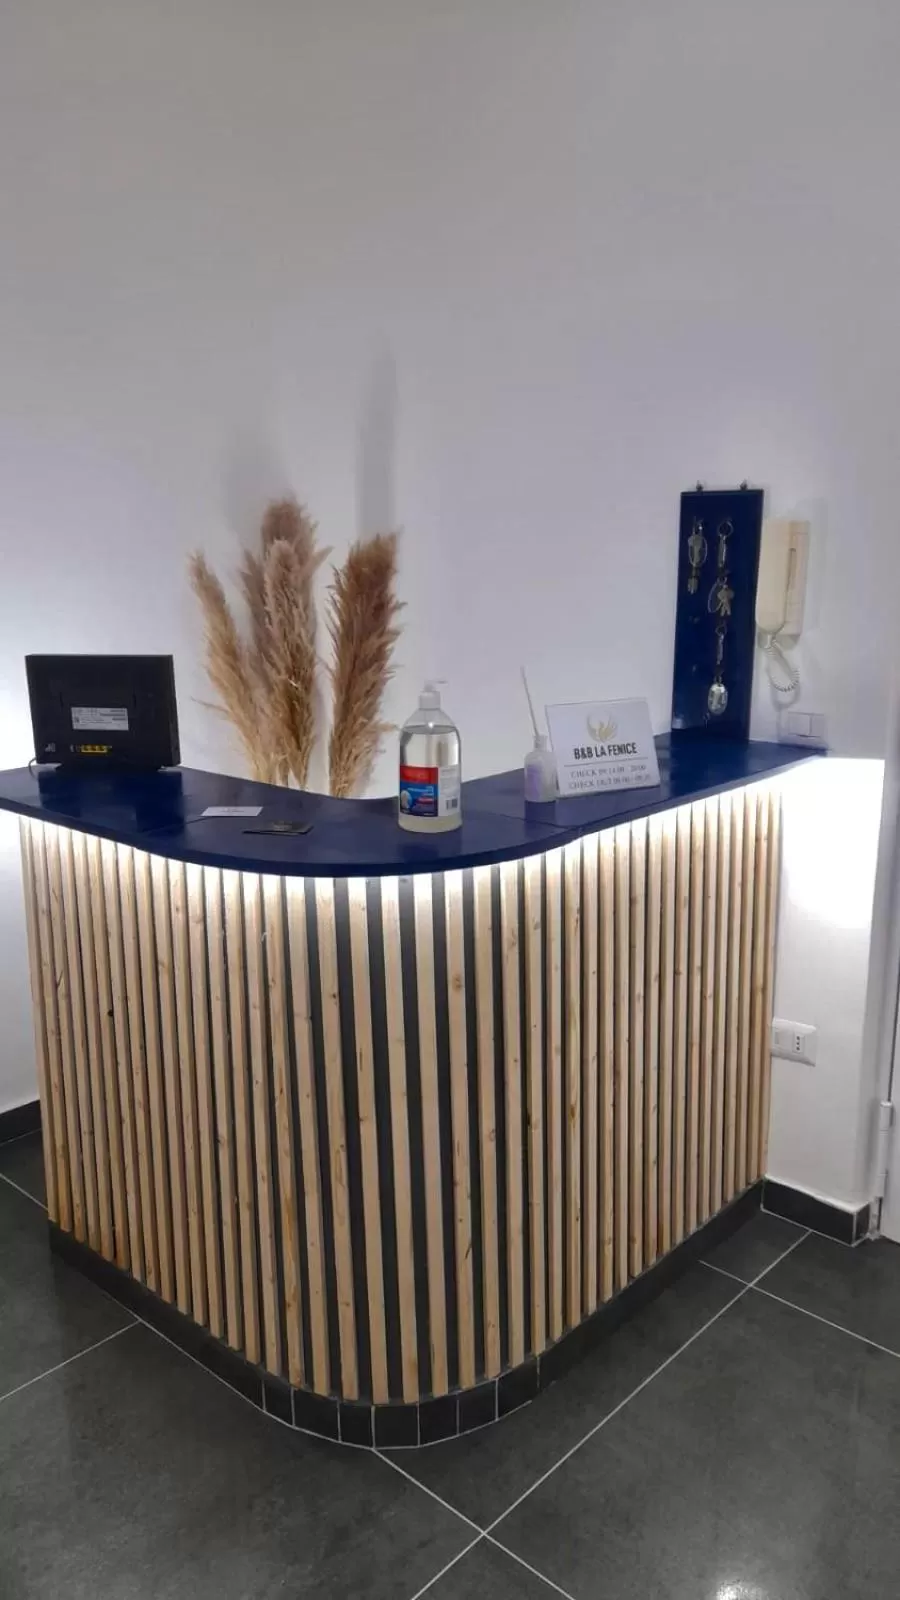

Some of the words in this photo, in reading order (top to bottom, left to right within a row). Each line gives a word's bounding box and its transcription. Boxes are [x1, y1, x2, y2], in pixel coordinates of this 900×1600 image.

[574, 747, 593, 760] B&B
[594, 745, 606, 757] LA
[607, 742, 637, 756] FENICE
